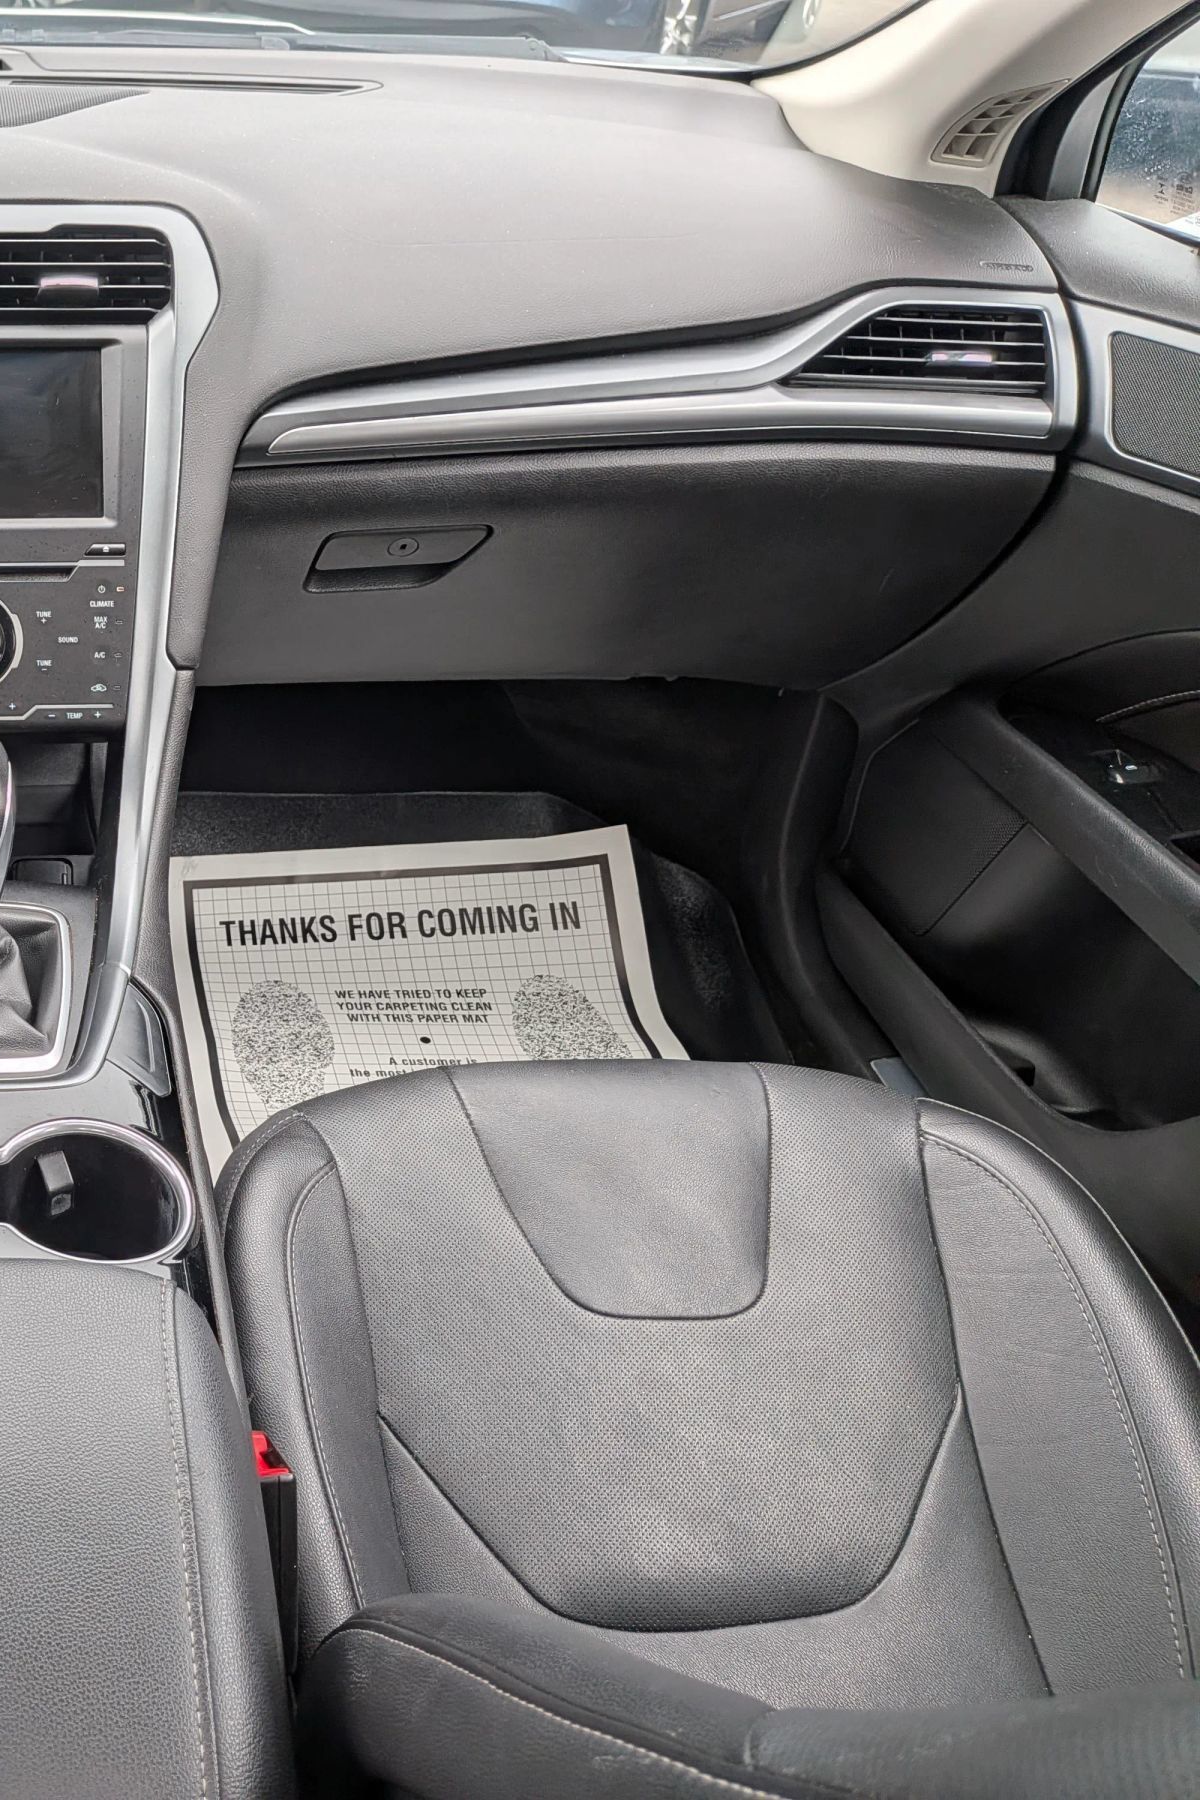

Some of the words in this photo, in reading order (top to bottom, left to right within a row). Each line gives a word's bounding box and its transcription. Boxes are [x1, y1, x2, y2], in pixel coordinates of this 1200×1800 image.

[219, 915, 338, 946] THANKS
[348, 912, 408, 941] FOR
[417, 903, 539, 938] COMING
[549, 901, 581, 930] IN
[334, 990, 354, 999] WE
[358, 990, 390, 999] HAVE
[393, 990, 431, 998] TRIED
[435, 989, 451, 998] TO
[455, 988, 487, 998] KEEP
[336, 1002, 372, 1011] YOUR
[376, 1002, 447, 1011] CARPETING
[451, 1002, 492, 1011] CLEAN
[347, 1014, 380, 1022] WITH
[384, 1014, 414, 1022] THIS
[418, 1014, 459, 1023] PAPER
[462, 1014, 488, 1023] MAT
[389, 1057, 398, 1065] A
[402, 1058, 461, 1066] customer
[350, 1069, 370, 1077] the
